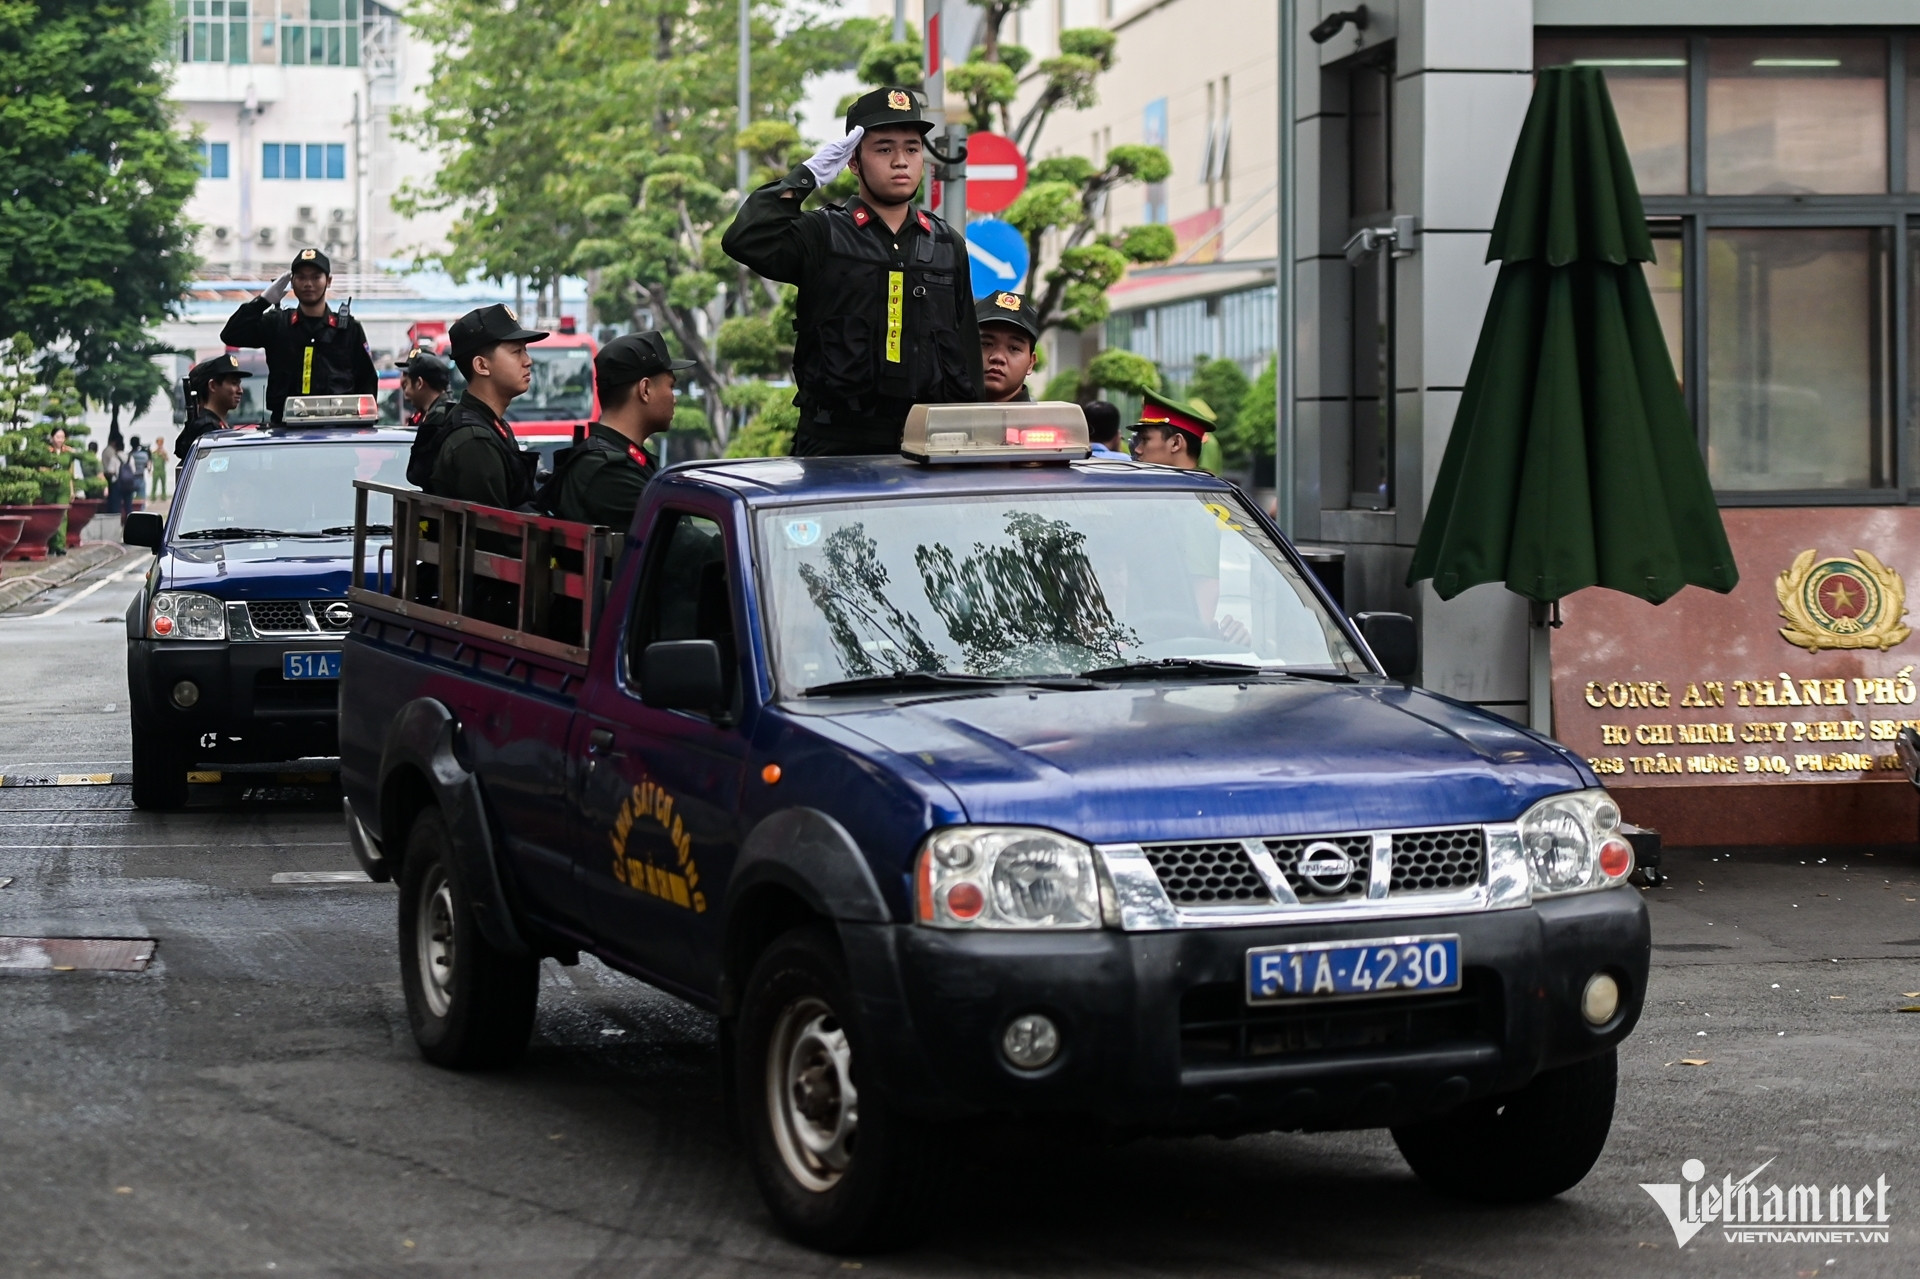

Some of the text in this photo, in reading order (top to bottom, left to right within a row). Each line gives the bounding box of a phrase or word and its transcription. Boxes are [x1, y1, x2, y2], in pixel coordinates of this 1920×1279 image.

[890, 284, 899, 350] POLICE
[290, 655, 341, 677] 51A-
[1681, 681, 1725, 707] AN
[1731, 672, 1848, 706] THÀNH
[1852, 665, 1917, 704] PHỐ
[1635, 724, 1674, 745] CHI
[1677, 723, 1736, 744] MINH
[1740, 722, 1788, 743] CITY
[1791, 720, 1866, 742] PUBLIC
[1588, 757, 1625, 774] 268
[1261, 943, 1448, 996] 51A-4230
